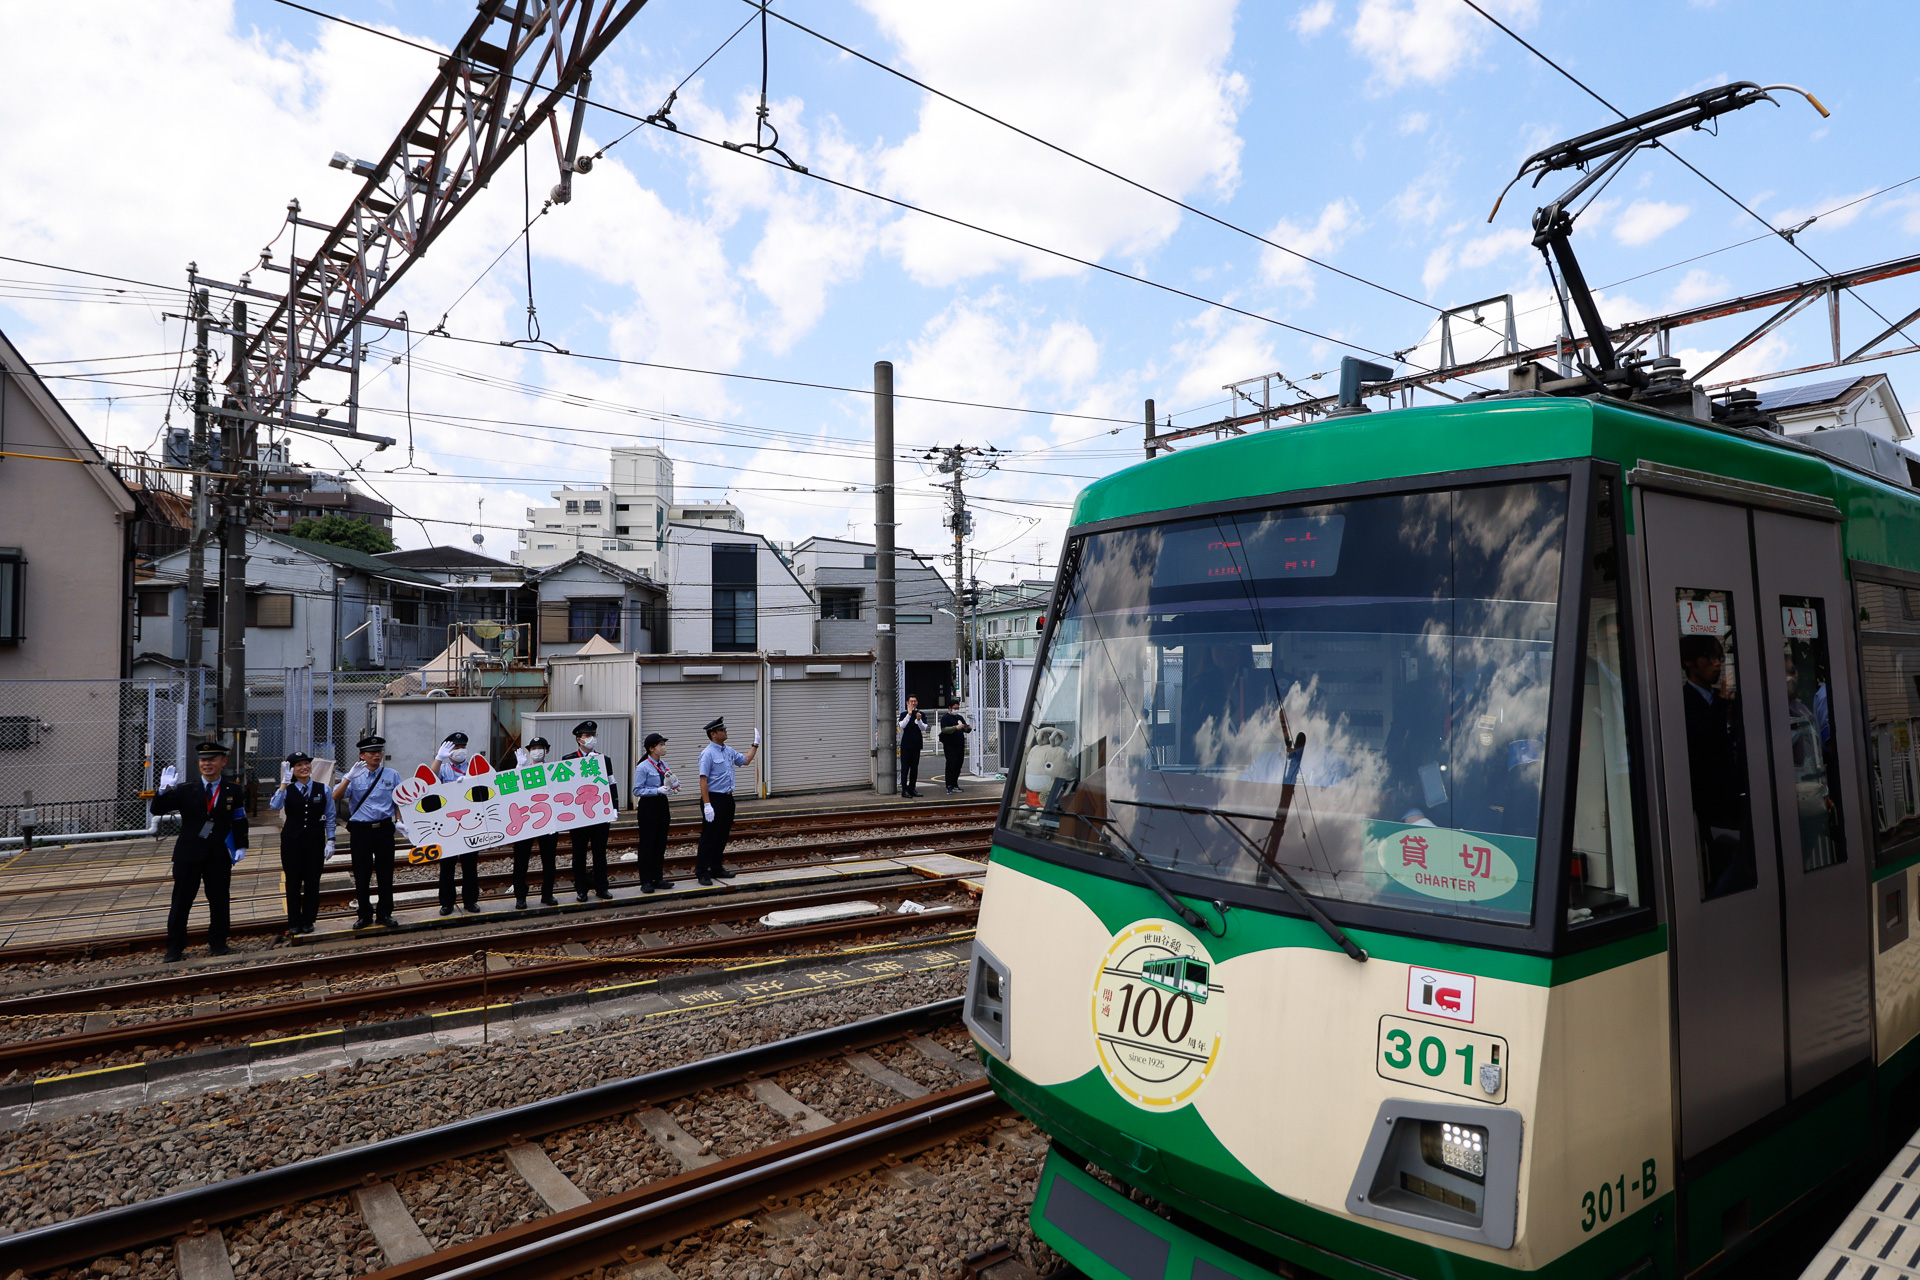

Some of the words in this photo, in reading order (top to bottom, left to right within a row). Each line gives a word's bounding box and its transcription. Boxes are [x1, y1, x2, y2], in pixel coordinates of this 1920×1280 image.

[1686, 602, 1719, 623] 入口
[1787, 608, 1813, 627] 入口
[1690, 624, 1717, 633] ENTRANCE
[1790, 628, 1812, 637] ENTRANCE
[469, 834, 502, 846] Welcome
[411, 844, 441, 864] SG
[1399, 834, 1492, 879] 貸切
[1415, 872, 1476, 893] CHARTER
[1143, 933, 1183, 953] 世田谷線
[1101, 988, 1113, 1018] 開通
[1117, 983, 1194, 1044] 100
[1187, 1037, 1207, 1052] 周年
[1128, 1052, 1147, 1065] since
[1148, 1056, 1166, 1069] 1925
[1384, 1028, 1474, 1086] 301
[1581, 1157, 1657, 1233] 301-B
